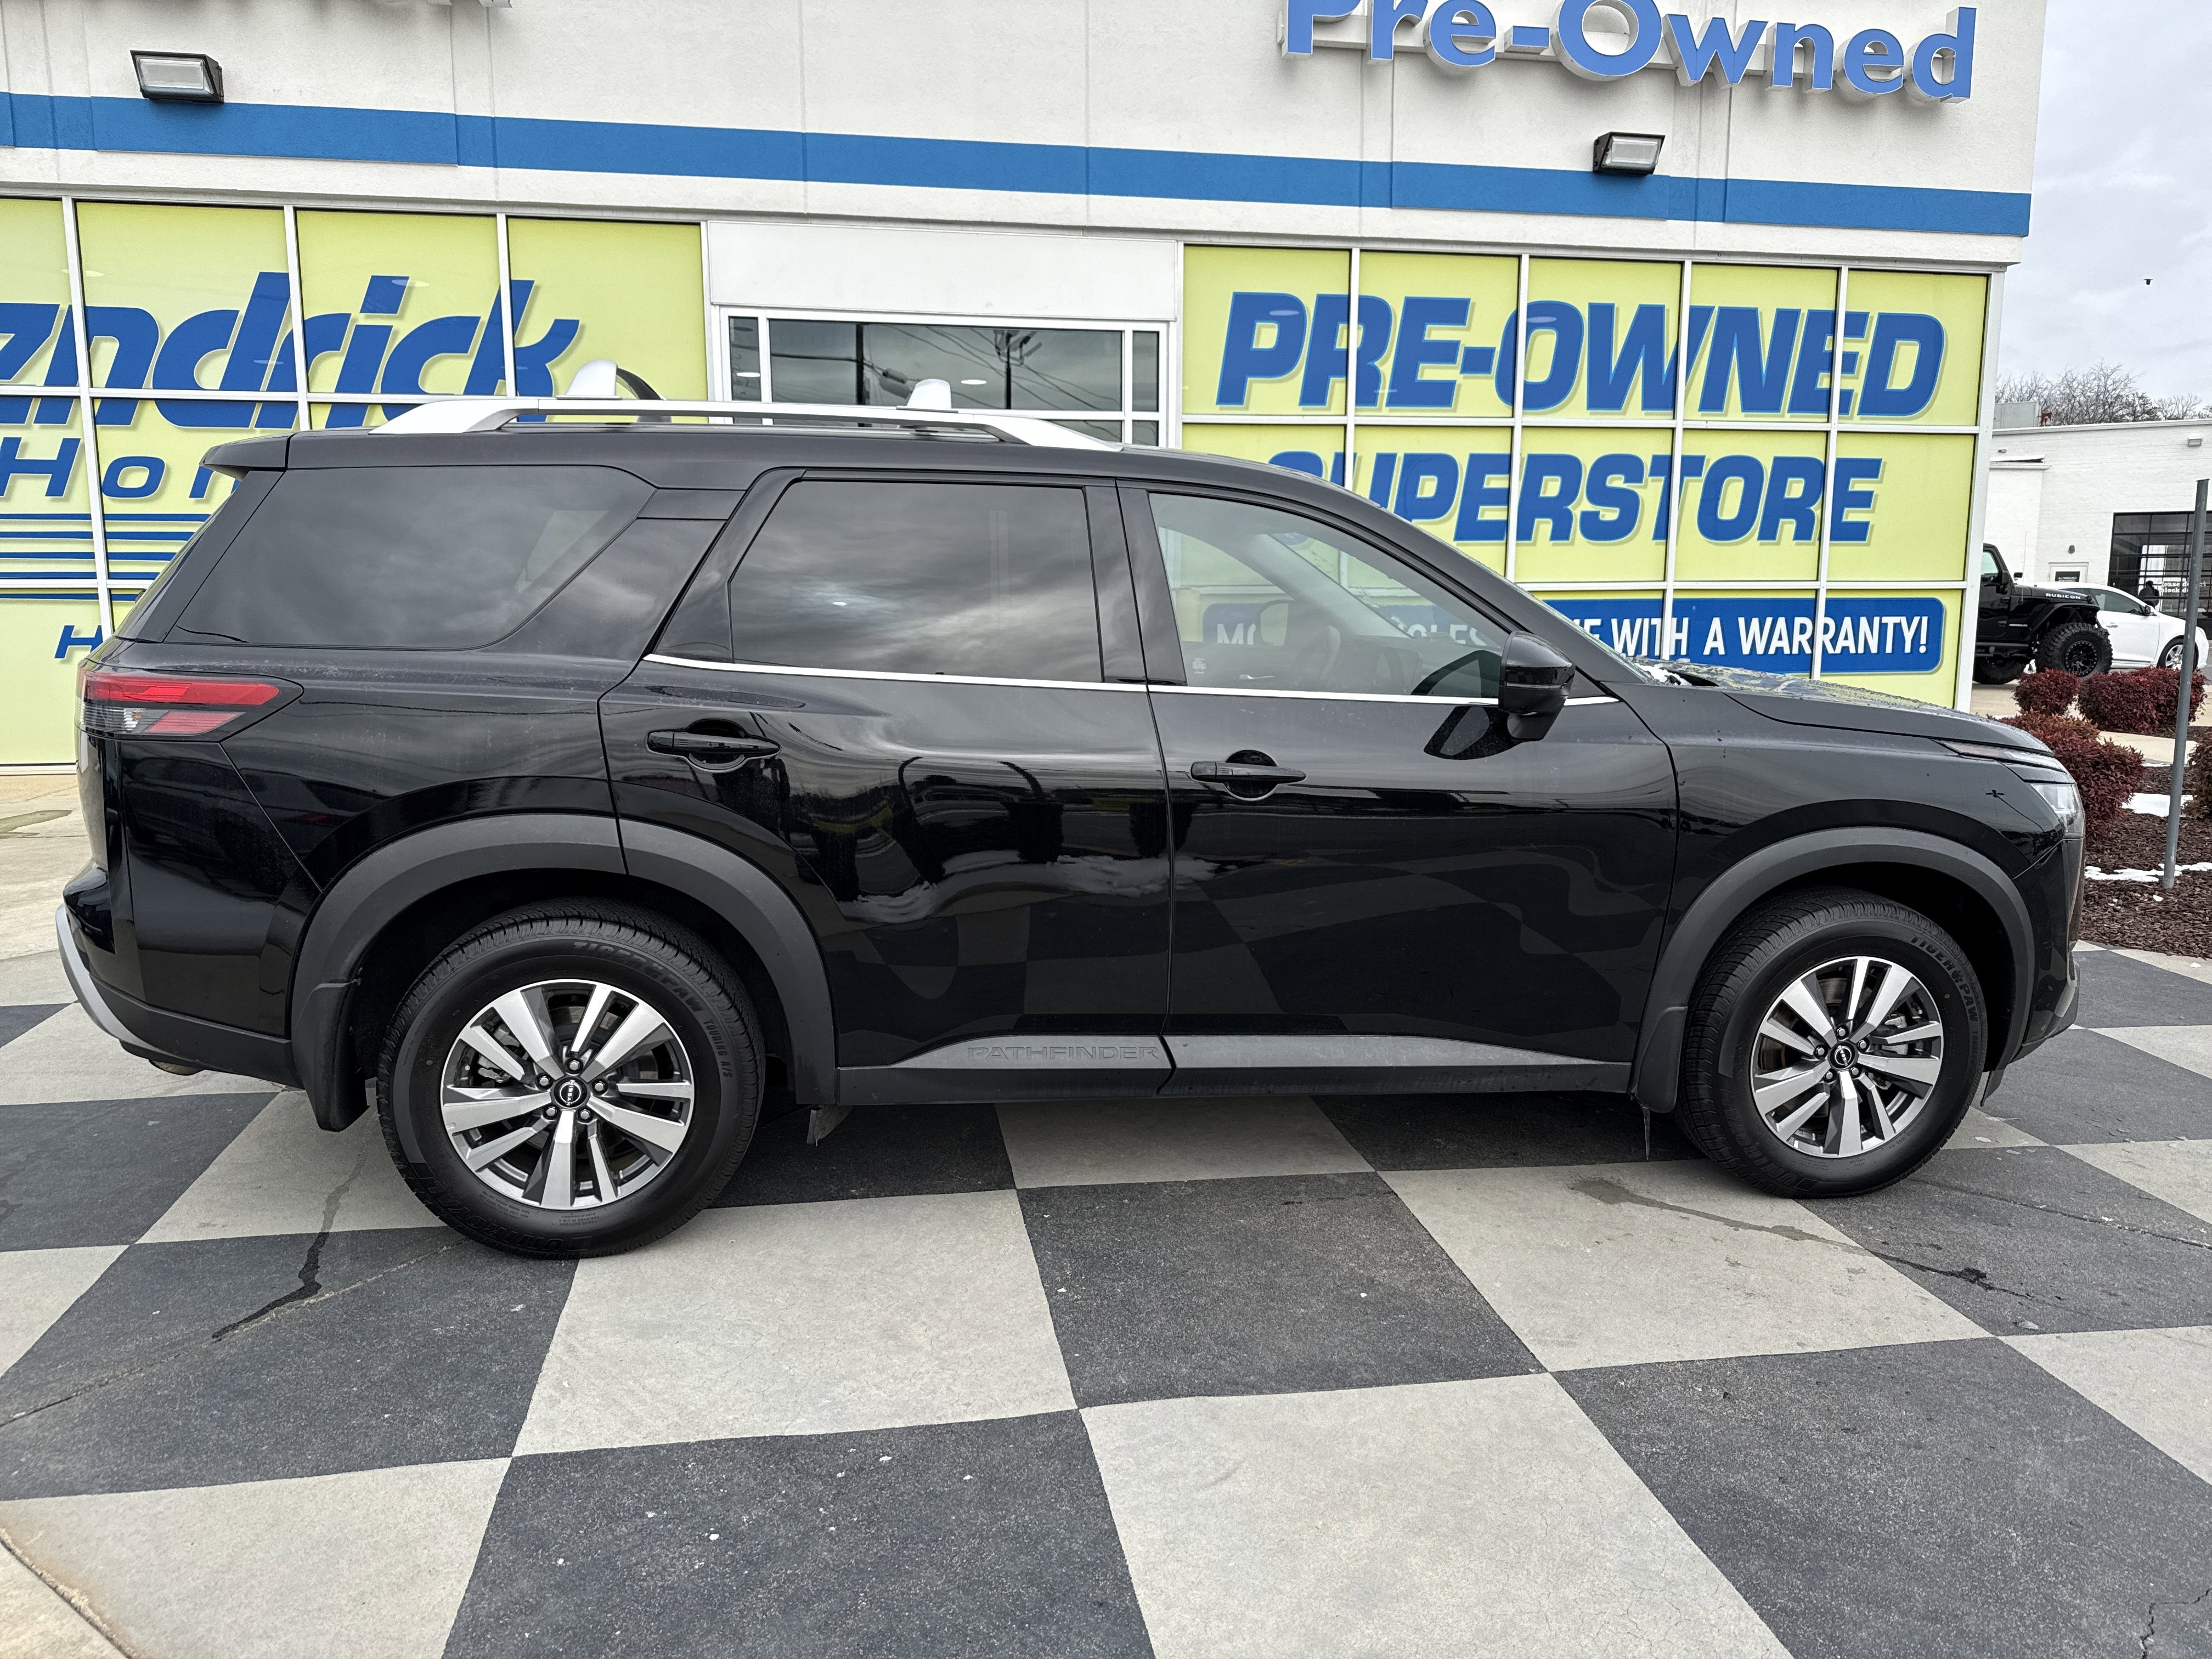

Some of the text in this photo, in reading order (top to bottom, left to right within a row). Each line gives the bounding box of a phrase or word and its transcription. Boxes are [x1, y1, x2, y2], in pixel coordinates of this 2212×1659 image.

[1283, 0, 1976, 103] Pre-Owned
[1216, 291, 1946, 417] PRE-OWNED
[1611, 618, 1689, 657] WITH
[1703, 617, 1725, 656] A
[1737, 616, 1928, 654] WARRANTY!
[574, 941, 733, 1077] TIGER PAW TOURING A/S
[1911, 935, 1955, 971] TIGER
[1958, 983, 1978, 1022] PAW
[968, 1046, 1159, 1060] PATHFINDER
[1837, 1045, 1848, 1066] NISSAN
[566, 1080, 575, 1105] NISSAN
[428, 1180, 563, 1252] UNIROYAL
